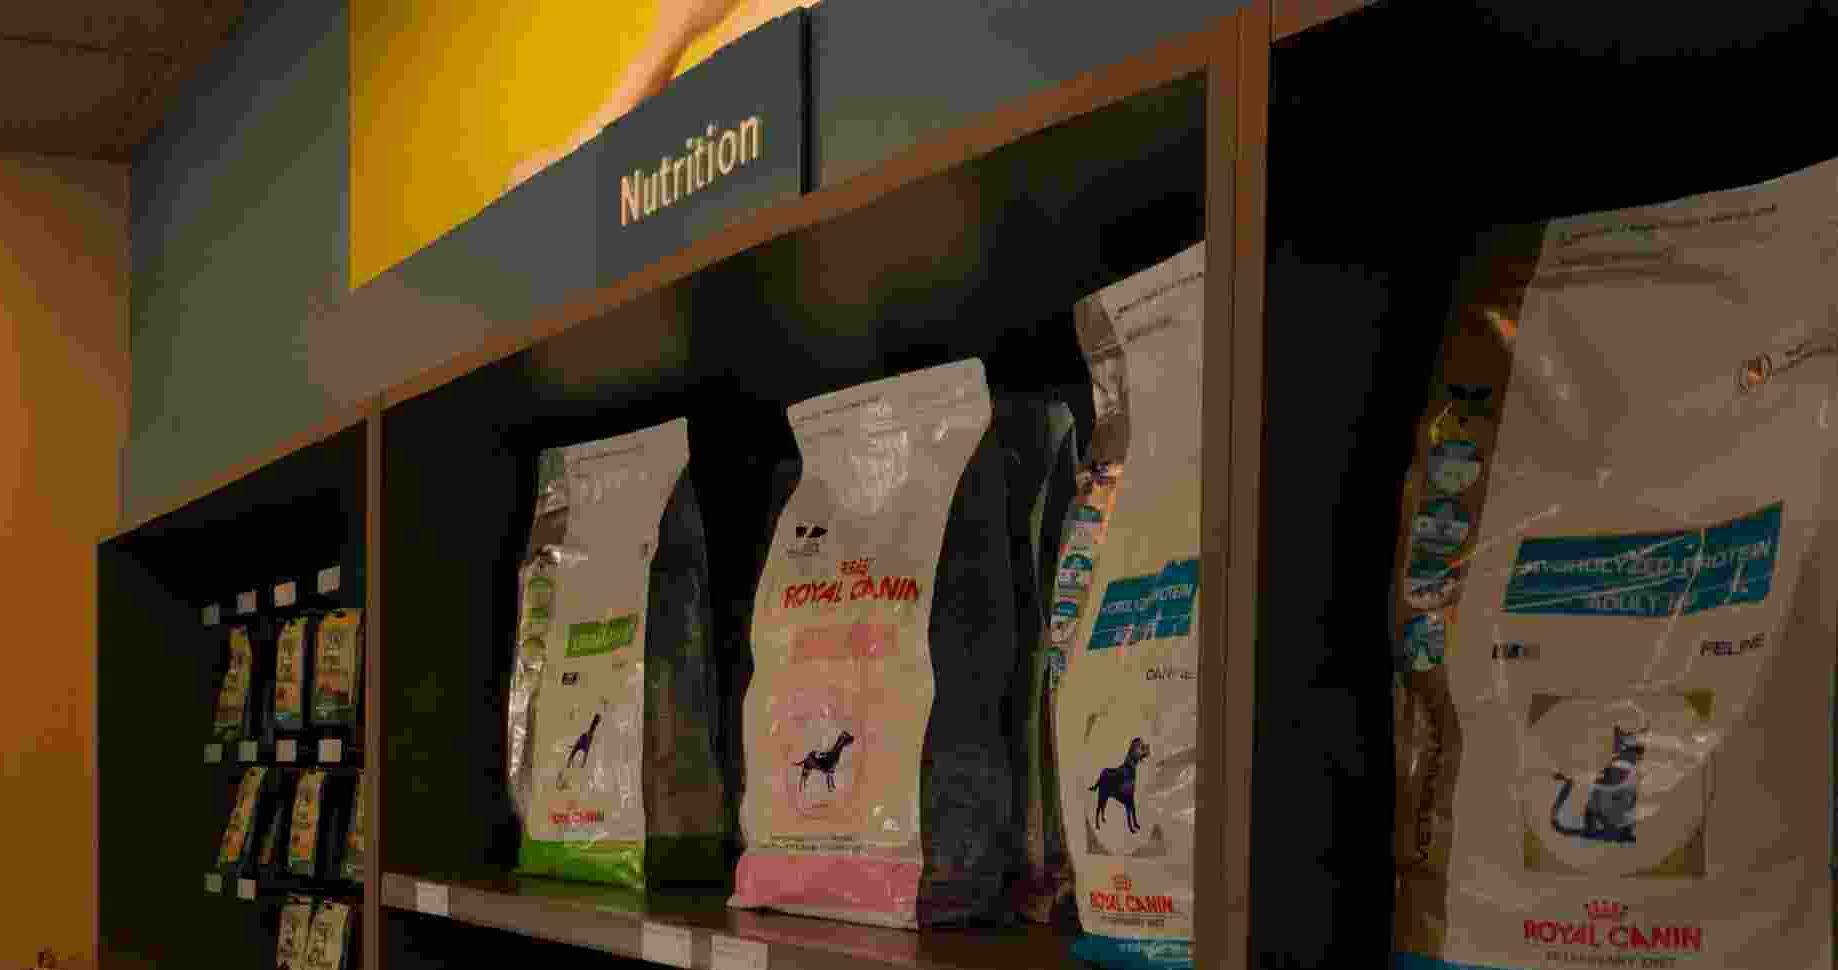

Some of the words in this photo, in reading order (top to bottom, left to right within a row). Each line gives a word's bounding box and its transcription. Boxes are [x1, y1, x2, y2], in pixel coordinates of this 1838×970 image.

[620, 115, 758, 227] Nutrition
[1700, 633, 1765, 657] FELINE
[1523, 919, 1599, 947] ROYAL
[1608, 926, 1702, 952] CANIN
